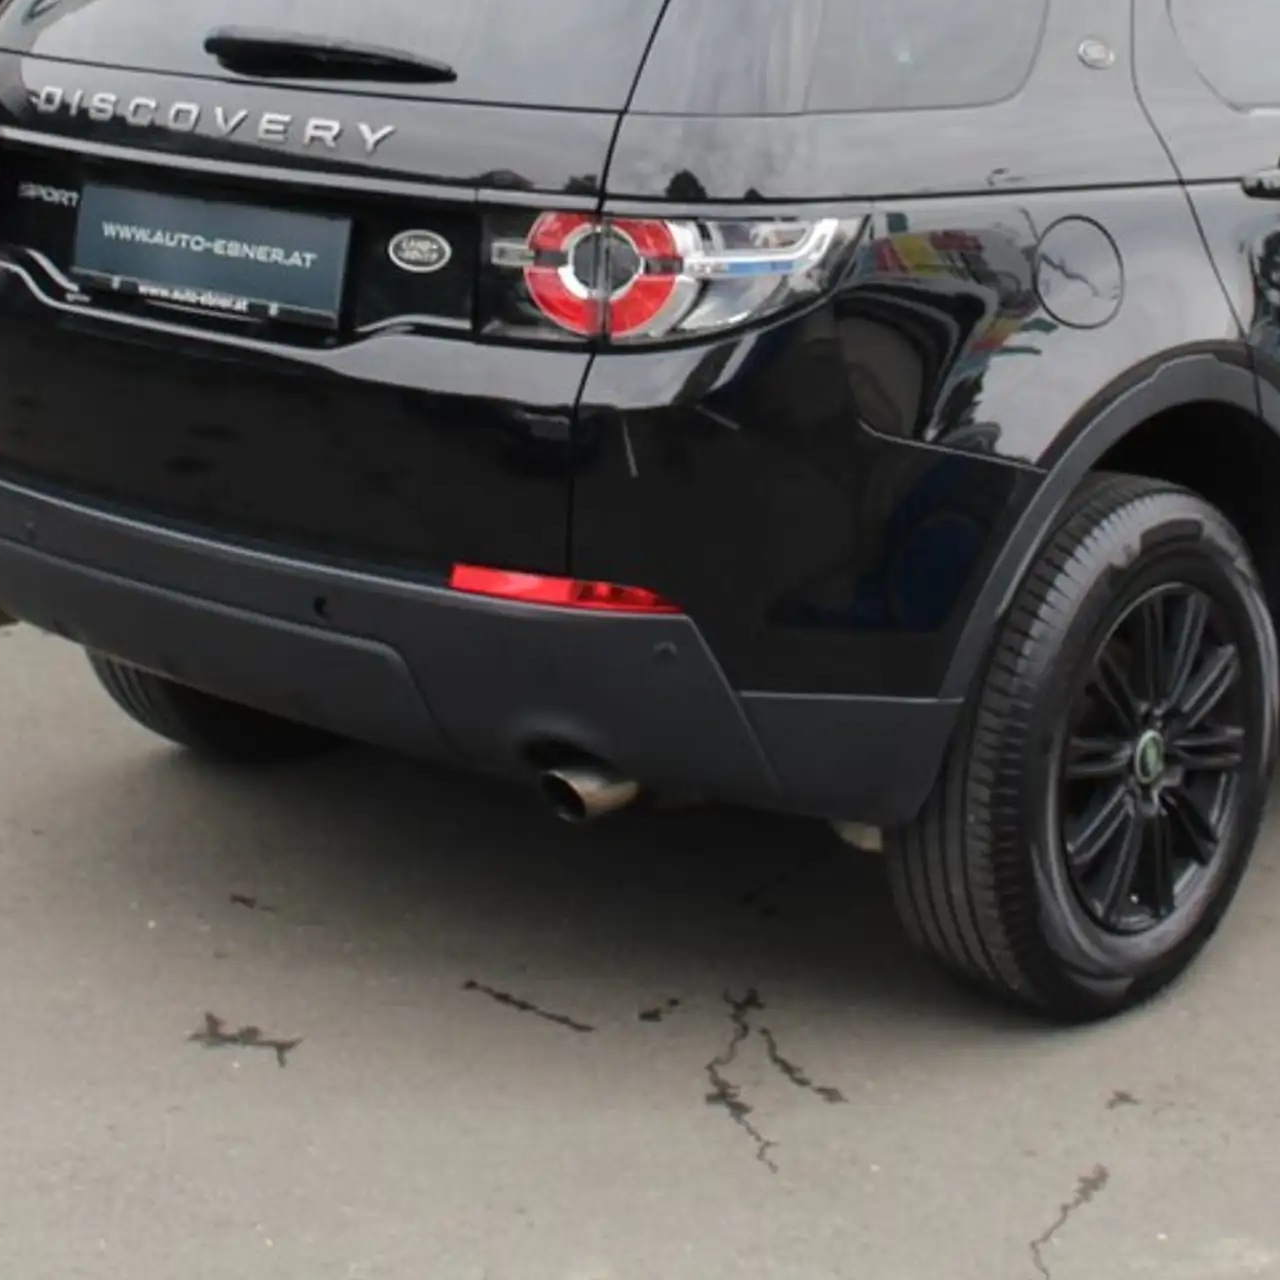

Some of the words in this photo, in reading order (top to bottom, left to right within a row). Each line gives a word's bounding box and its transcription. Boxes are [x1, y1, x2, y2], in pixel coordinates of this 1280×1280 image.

[32, 85, 395, 154] DISCOVERY
[19, 183, 80, 208] SPORT
[102, 221, 318, 269] WWW.AUTO-EBNER.AT
